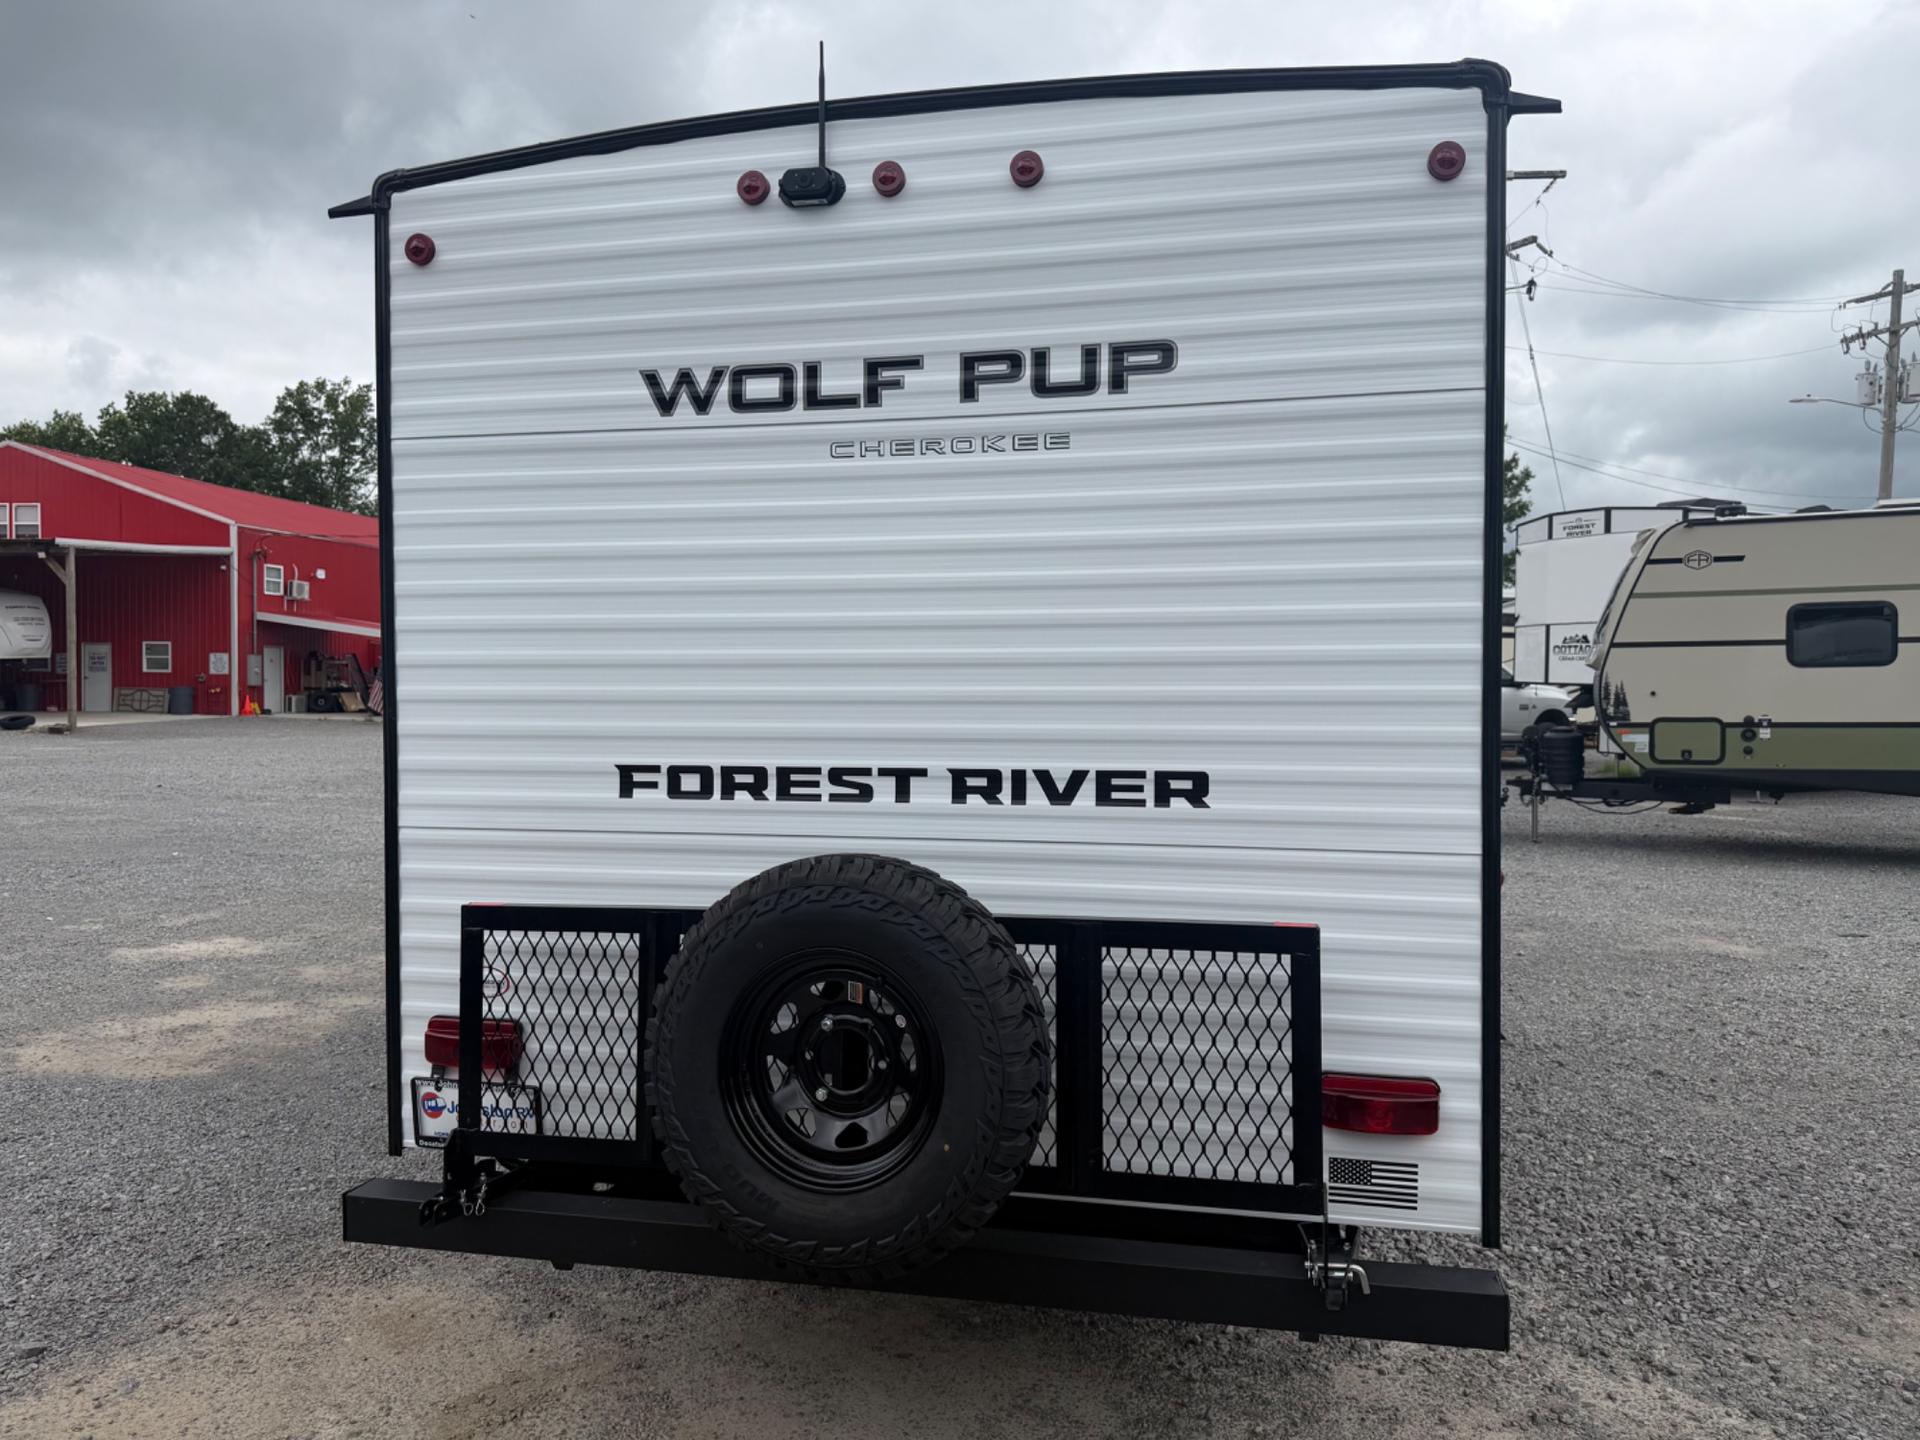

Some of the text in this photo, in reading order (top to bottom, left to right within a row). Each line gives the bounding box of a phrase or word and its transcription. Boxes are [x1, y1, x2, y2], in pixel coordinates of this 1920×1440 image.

[639, 339, 1179, 417] WOLF PUP
[830, 432, 1070, 459] CHEROKEE
[1563, 523, 1596, 531] FOREST
[614, 764, 1211, 809] FOREST RIVER
